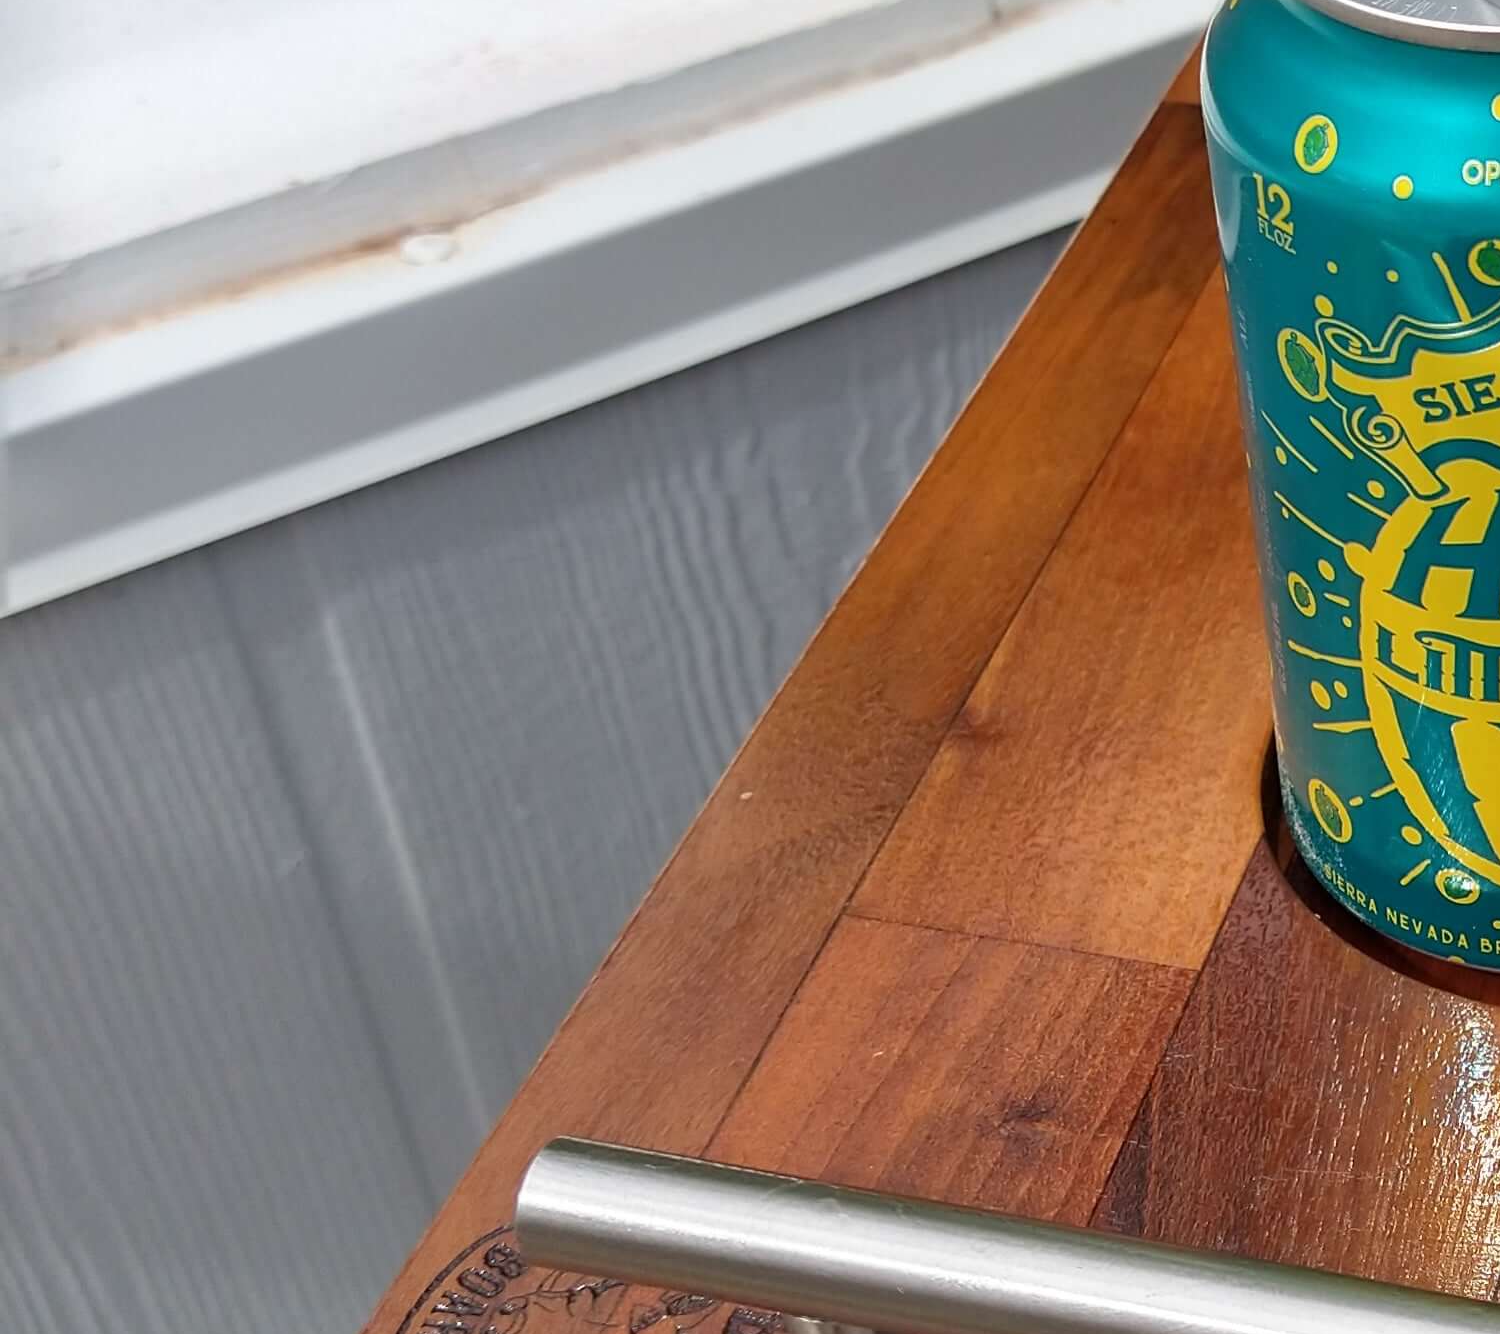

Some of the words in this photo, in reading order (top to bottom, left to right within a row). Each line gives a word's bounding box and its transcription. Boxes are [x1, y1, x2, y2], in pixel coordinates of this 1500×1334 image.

[1252, 171, 1294, 236] 12
[1323, 863, 1379, 916] SIERRA
[1385, 907, 1469, 949] NEVADA
